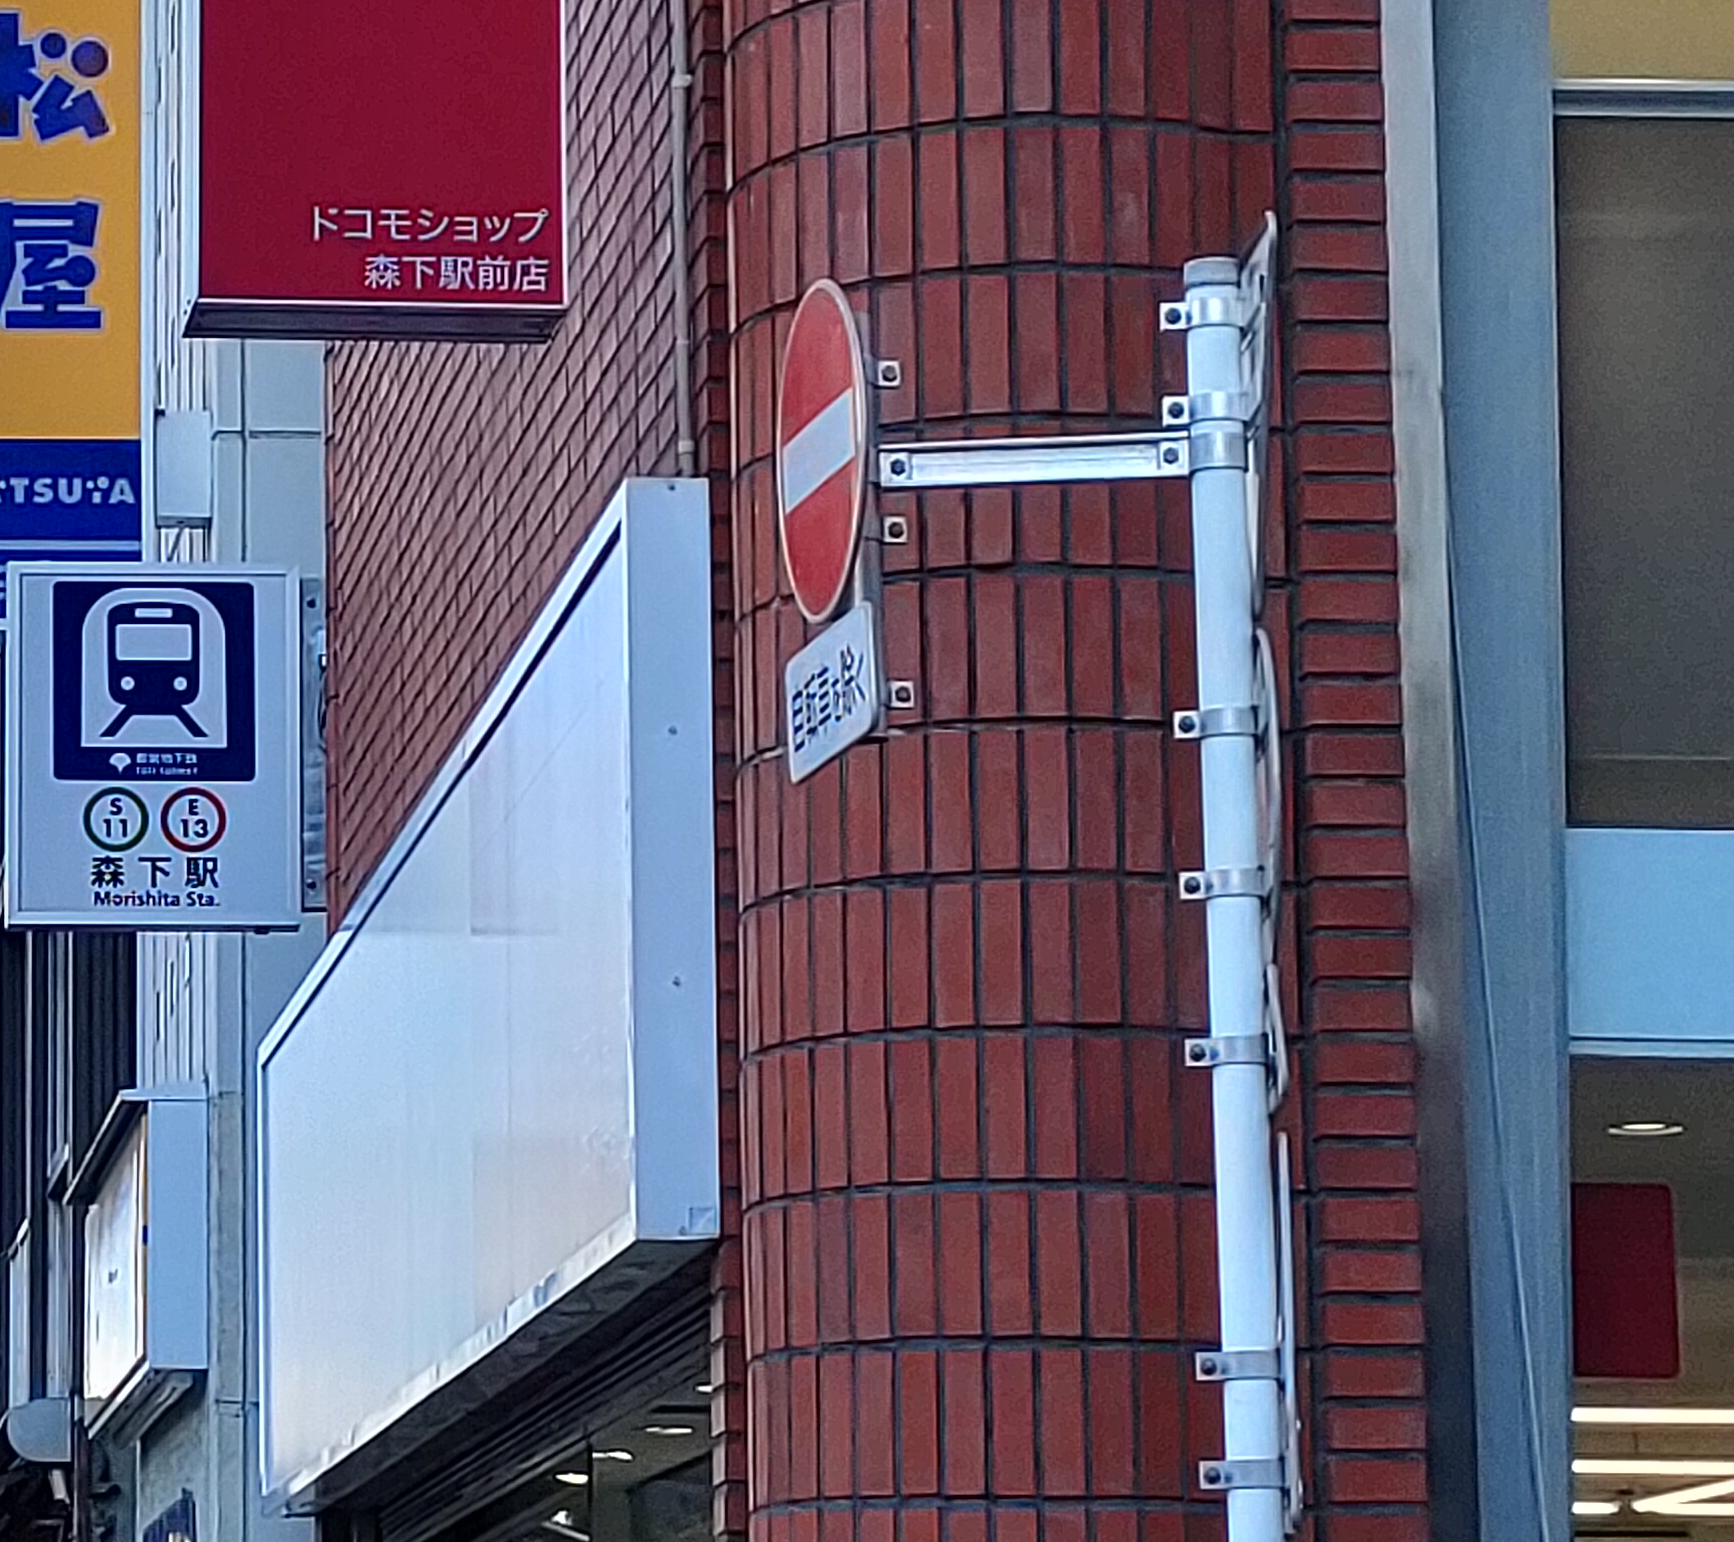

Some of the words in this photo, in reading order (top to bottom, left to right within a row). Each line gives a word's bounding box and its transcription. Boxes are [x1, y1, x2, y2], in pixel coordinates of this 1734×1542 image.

[313, 205, 550, 243] ドコモショップ
[364, 254, 550, 292] 森下駅前店
[110, 798, 123, 816] S
[188, 798, 199, 816] E
[103, 818, 128, 838] 11
[180, 818, 209, 838] 13
[91, 856, 219, 889] 森下駅
[94, 891, 180, 907] Morishita
[186, 891, 221, 907] Sta.
